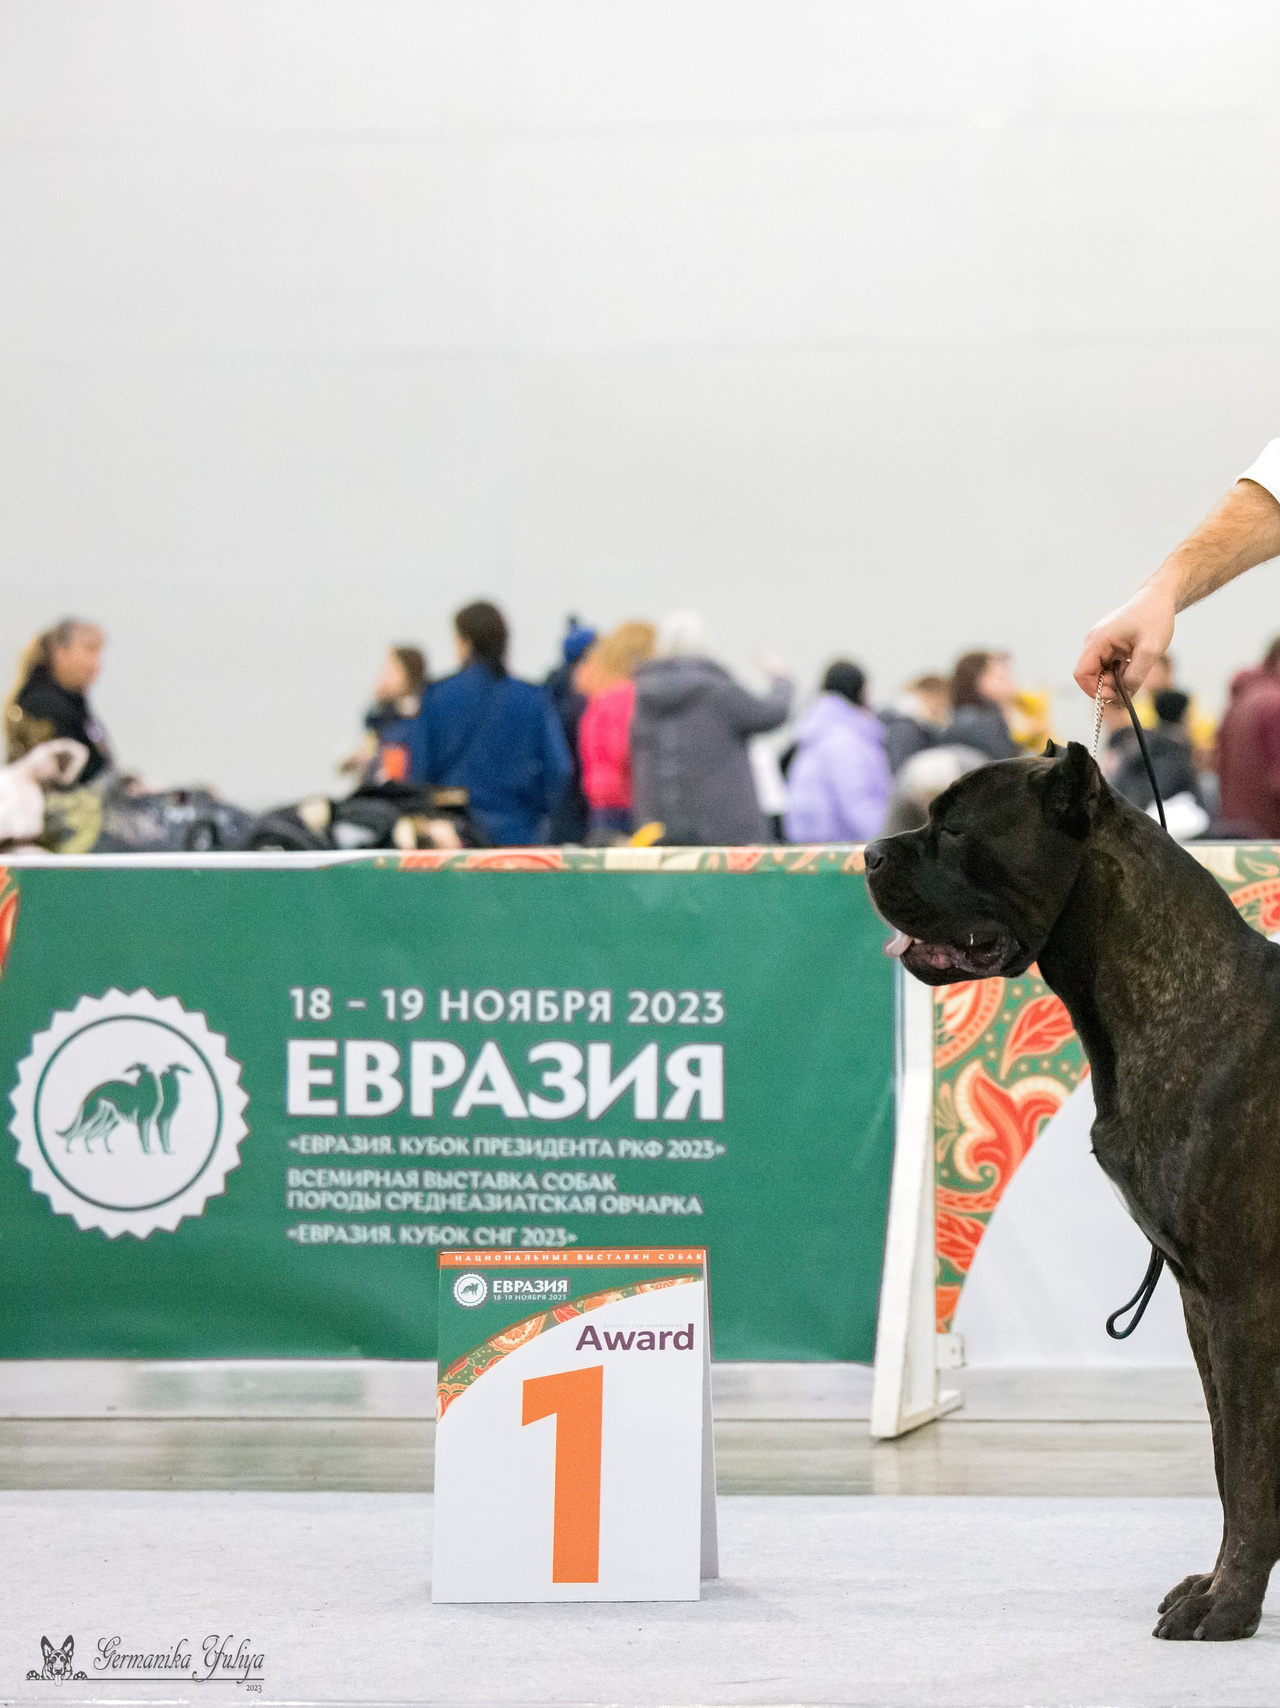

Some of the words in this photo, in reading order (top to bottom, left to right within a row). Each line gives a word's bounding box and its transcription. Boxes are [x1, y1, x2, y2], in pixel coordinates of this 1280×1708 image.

[289, 986, 332, 1021] 18
[380, 987, 425, 1022] 19
[439, 987, 612, 1024] НОЯБРЯ
[626, 989, 725, 1025] 2023
[286, 1038, 725, 1121] ЕВРАЗИЯ
[400, 1135, 470, 1157] КУБОК
[473, 1136, 615, 1160] ПРЕЗИДЕНТА
[617, 1138, 664, 1159] РКФ
[286, 1167, 420, 1188] ВСЕМИРНАЯ
[422, 1169, 540, 1191] ВЫСТАВКА
[541, 1171, 617, 1192] СОБАК
[286, 1190, 382, 1212] ПОРОДЫ
[384, 1191, 597, 1214] СРЕДНЕАЗИАТСКАЯ
[600, 1194, 704, 1215] ОВЧАРКА
[400, 1225, 470, 1246] КУБОК
[473, 1226, 517, 1247] СНГ
[455, 1253, 569, 1262] НАЦИОНАЛЬНЫЕ
[576, 1253, 650, 1261] ВЫСТАВКИ
[658, 1253, 703, 1261] СОБАК
[492, 1279, 568, 1294] ЕВРАЗИЯ
[515, 1293, 547, 1301] НОЯБРЯ
[548, 1293, 568, 1301] 2023
[575, 1323, 695, 1351] Award
[521, 1364, 604, 1584] 1
